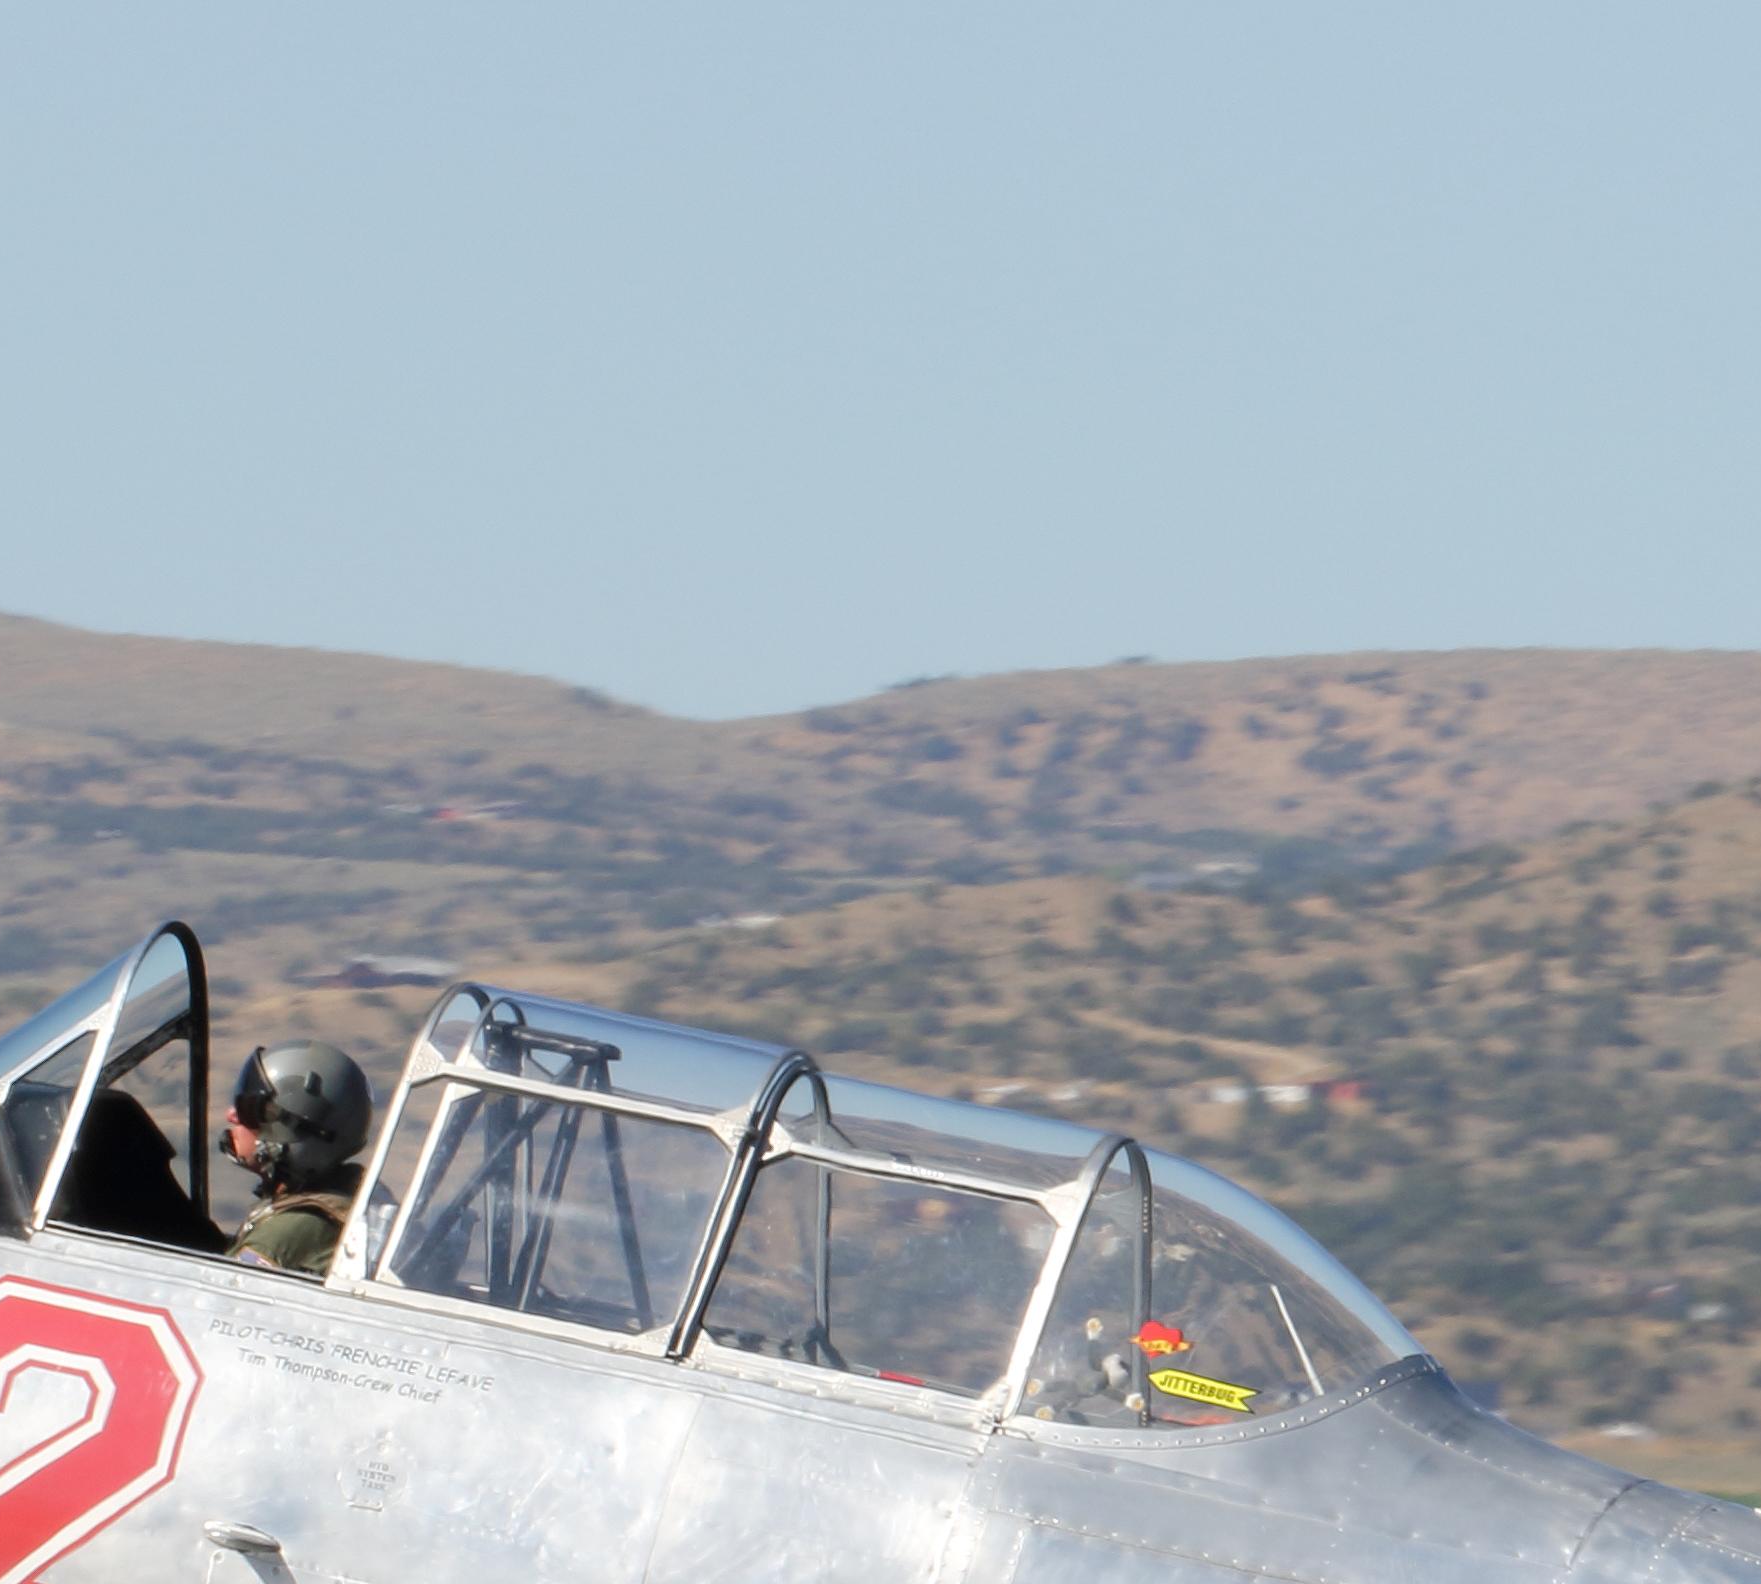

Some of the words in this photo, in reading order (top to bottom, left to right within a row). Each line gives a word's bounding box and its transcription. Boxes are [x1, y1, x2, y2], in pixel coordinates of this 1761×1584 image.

[209, 1319, 326, 1354] PILOT-CHRIS
[425, 1365, 496, 1392] LEFAVE
[238, 1347, 266, 1367] Tim
[274, 1354, 393, 1394] Thompson-Crew
[397, 1383, 443, 1404] Chief
[1159, 1374, 1237, 1403] JITTERBUG
